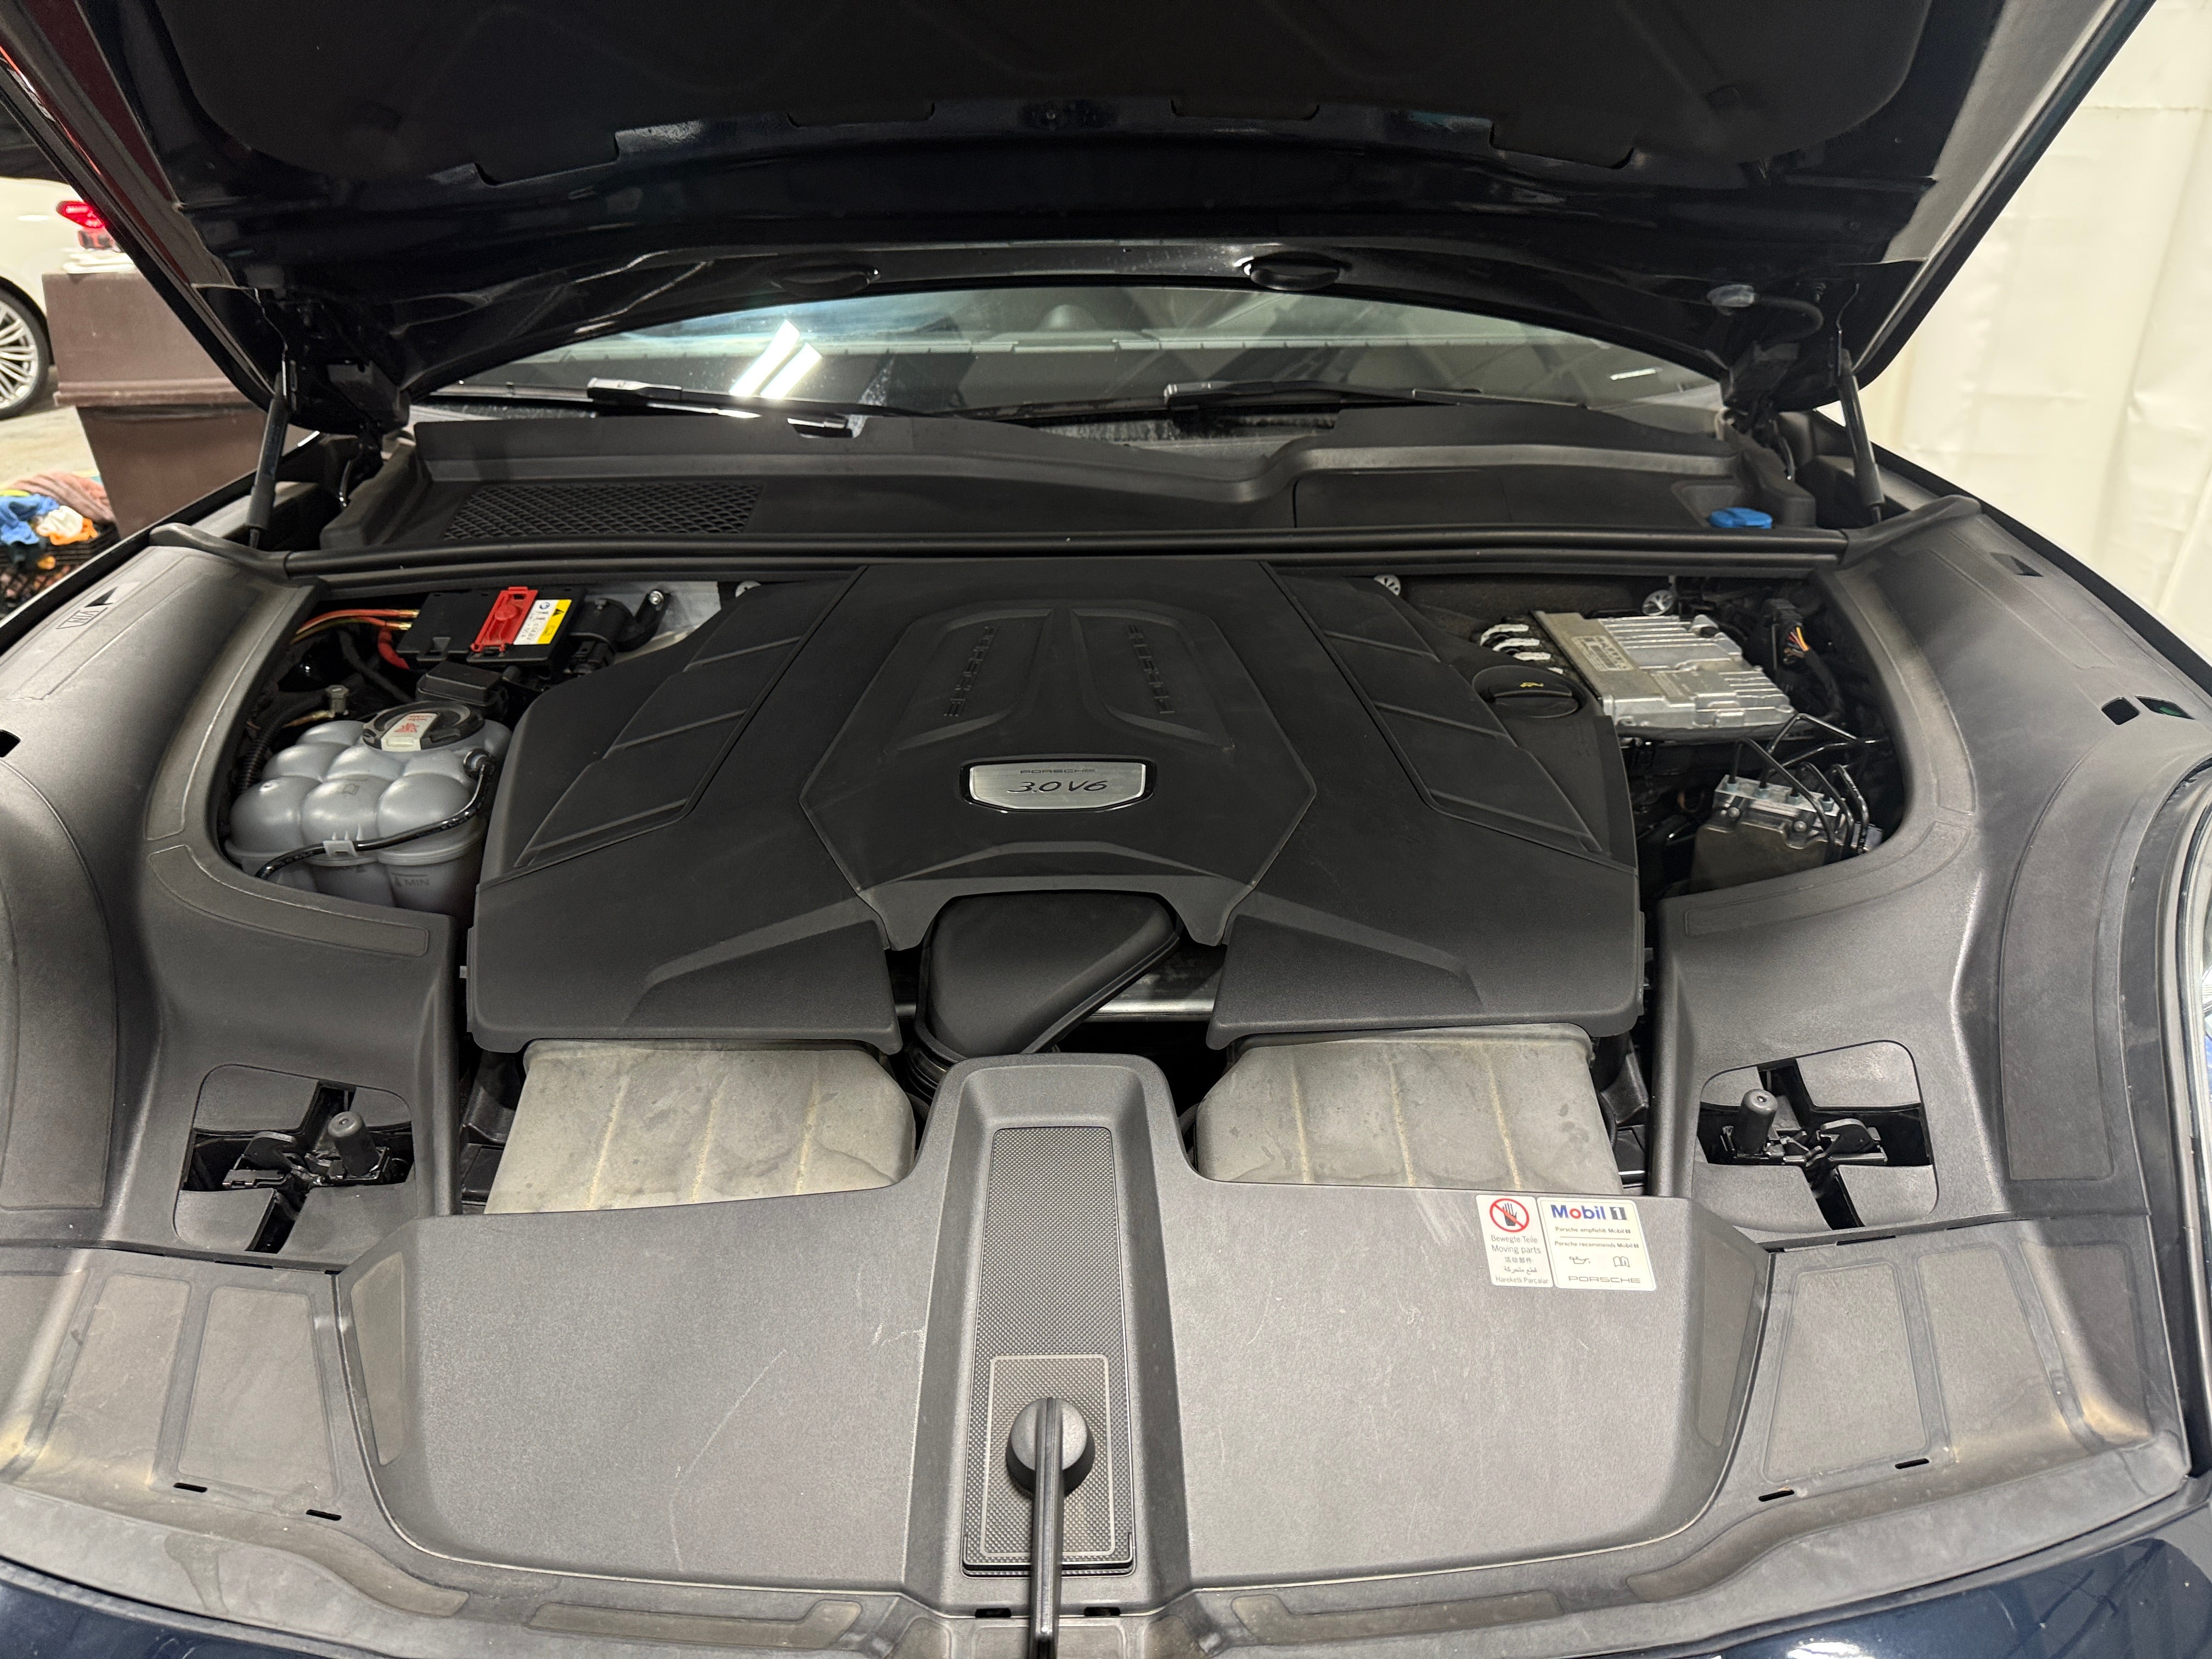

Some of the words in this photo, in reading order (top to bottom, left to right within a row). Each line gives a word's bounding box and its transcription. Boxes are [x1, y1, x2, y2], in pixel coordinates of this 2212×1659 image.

[67, 611, 99, 623] VIN
[1007, 781, 1062, 793] 3.0
[1069, 780, 1108, 792] V6
[404, 878, 430, 887] MIN
[1550, 1204, 1606, 1220] Mobil
[1609, 1206, 1627, 1221] 1
[1491, 1234, 1521, 1243] Bewegte
[1492, 1245, 1520, 1254] Moving
[1495, 1275, 1522, 1283] Hareketli
[1568, 1276, 1641, 1284] PORSCHE
